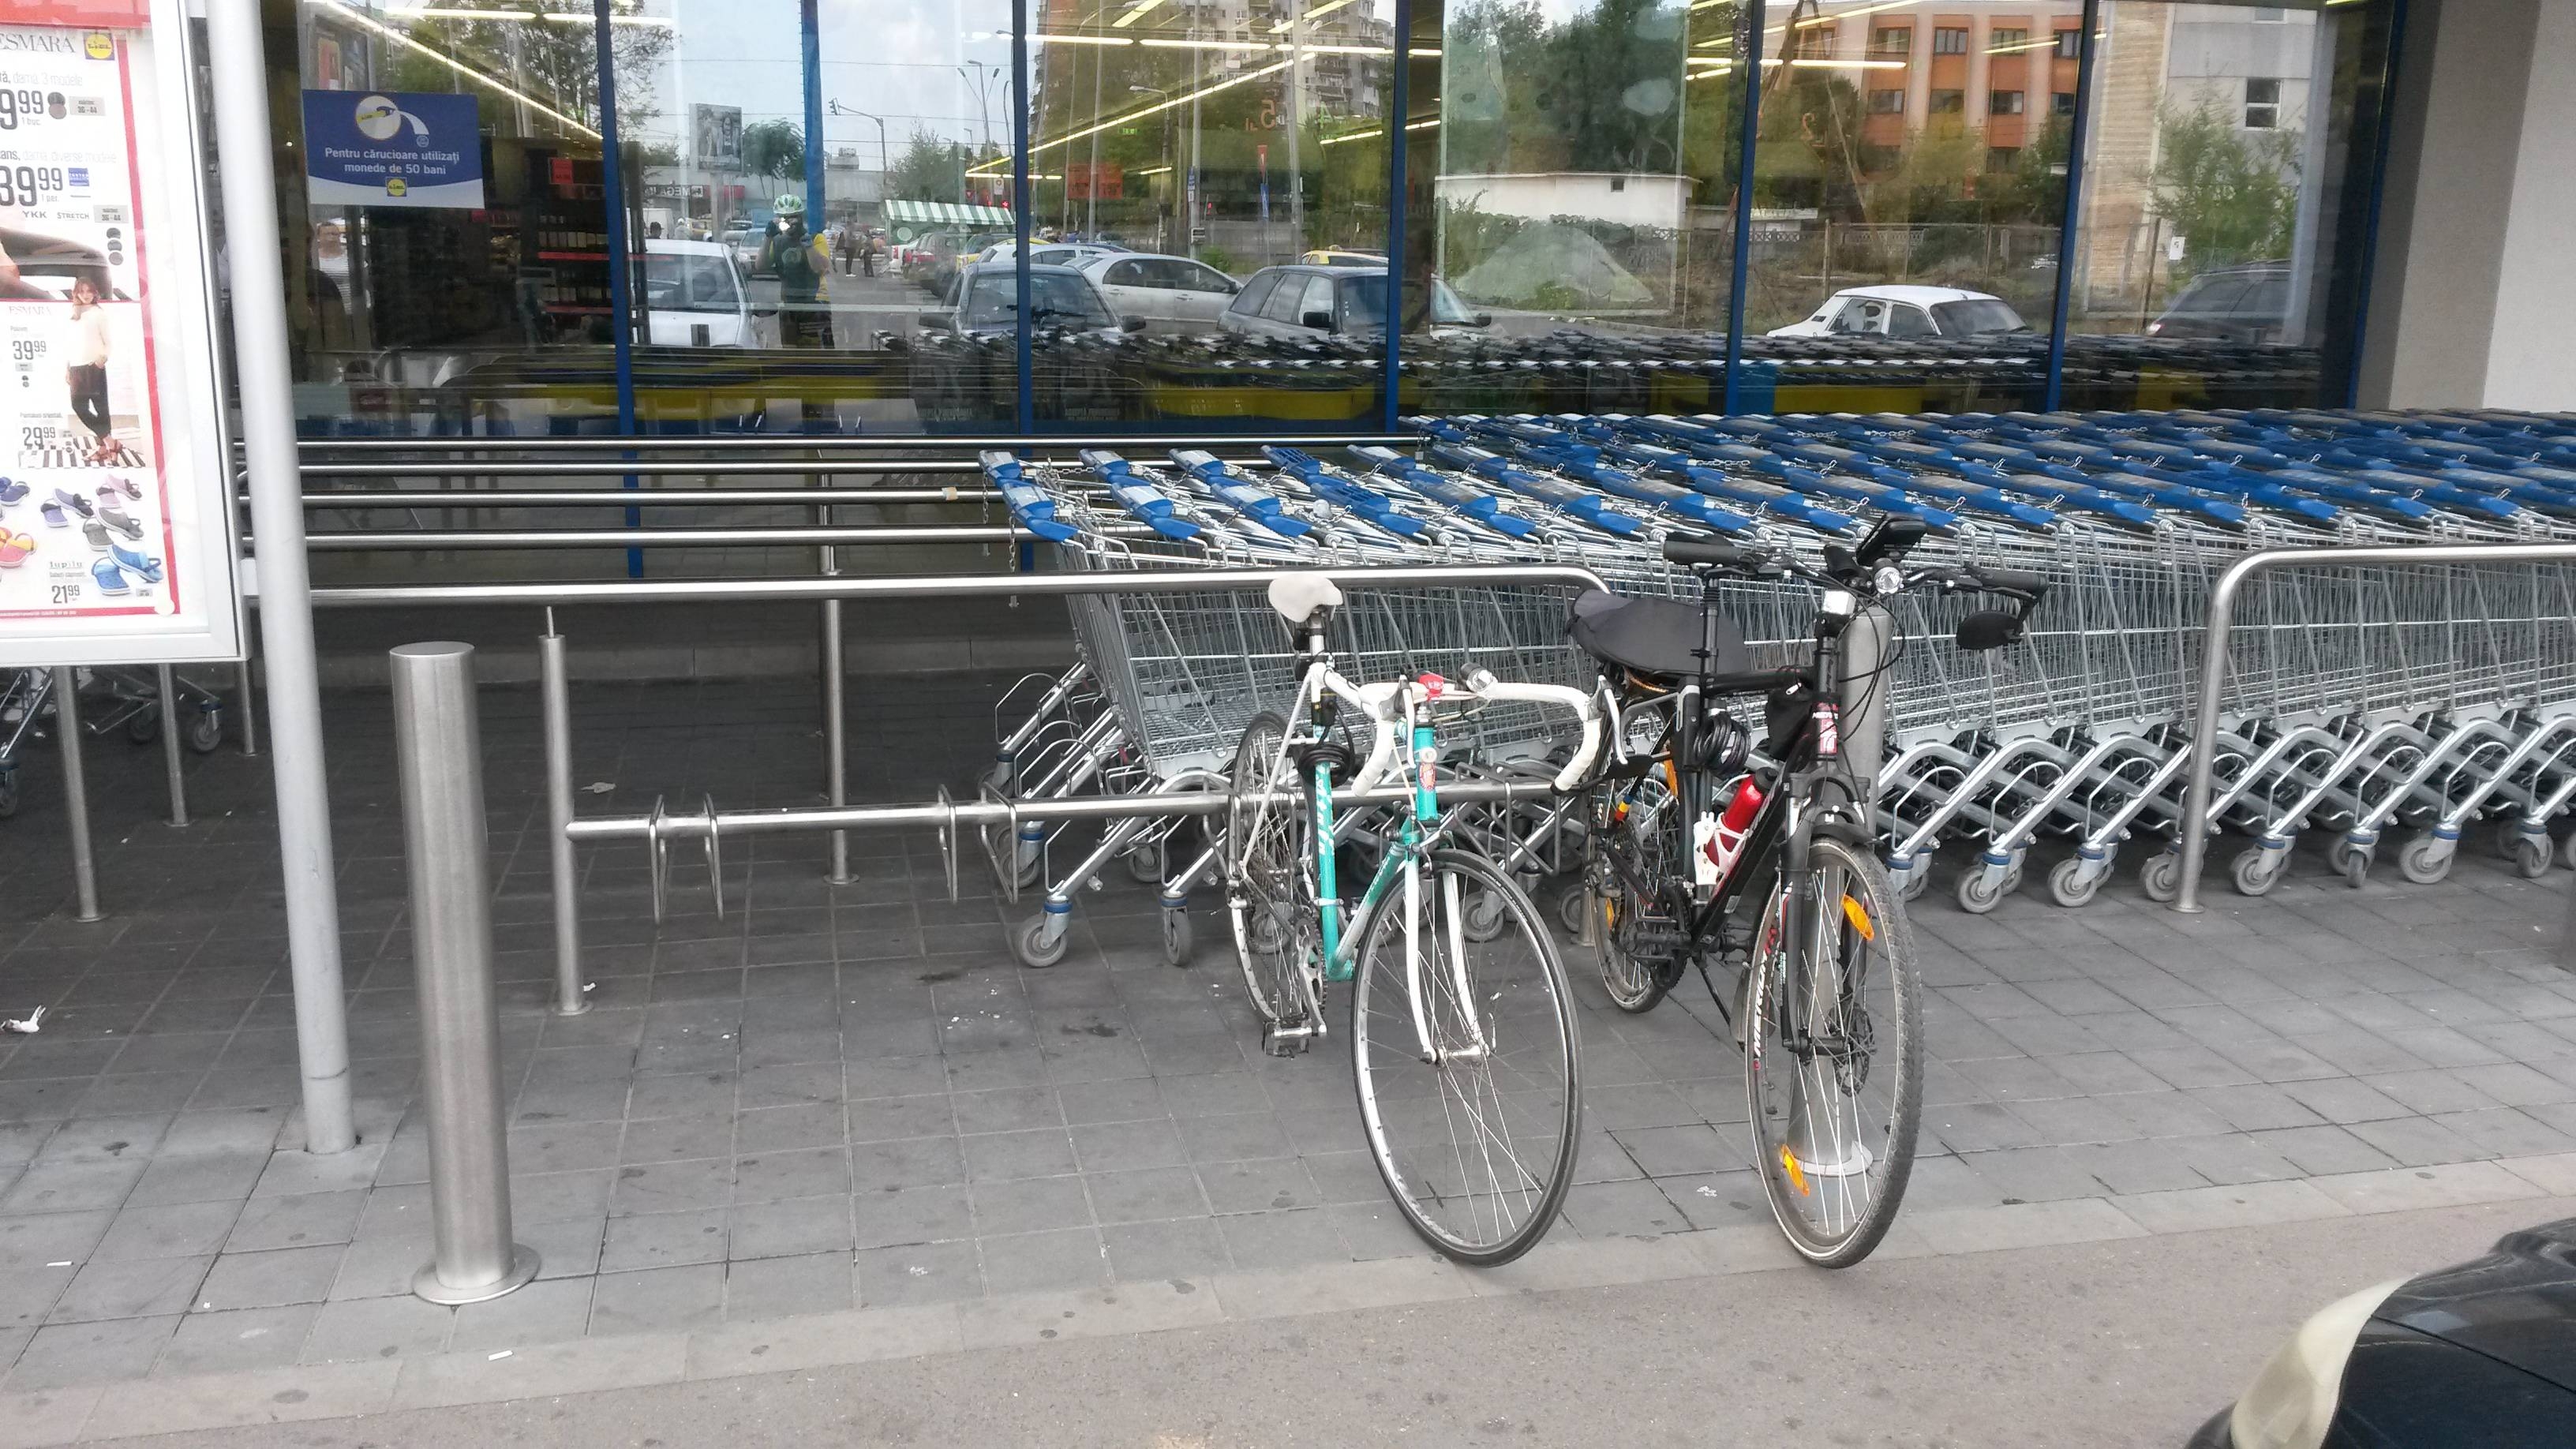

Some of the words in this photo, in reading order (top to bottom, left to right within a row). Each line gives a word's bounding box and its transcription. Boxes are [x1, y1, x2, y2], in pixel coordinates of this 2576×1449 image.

[324, 148, 361, 159] Pentru
[363, 149, 418, 160] cărucioare
[344, 163, 386, 173] monede
[389, 164, 402, 173] de
[406, 164, 420, 174] 50
[424, 164, 446, 174] bani
[22, 210, 47, 219] YKK
[57, 212, 89, 220] STRETCH
[13, 341, 34, 360] 39
[34, 340, 47, 352] 99
[22, 427, 43, 447] 29
[43, 426, 56, 438] 99
[51, 585, 68, 604] 21
[68, 584, 80, 596] 99
[1754, 949, 1768, 1058] MERIDA
